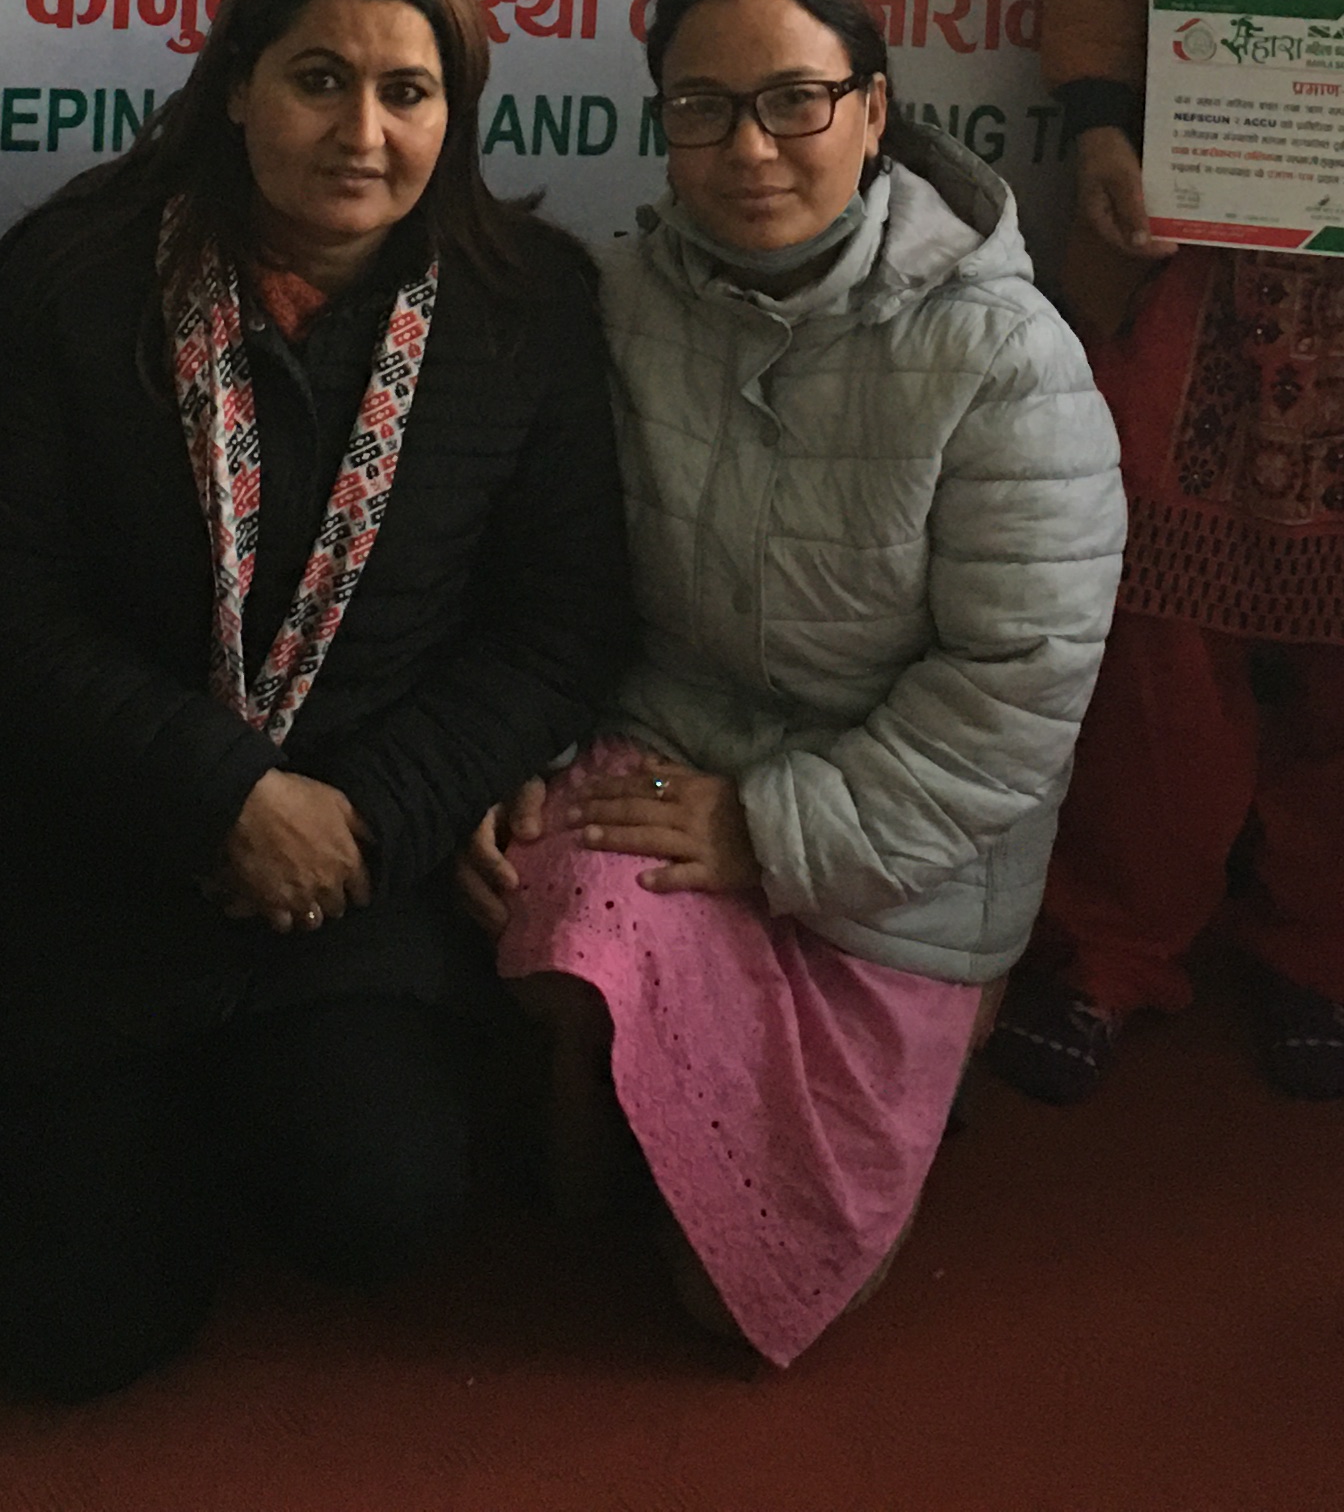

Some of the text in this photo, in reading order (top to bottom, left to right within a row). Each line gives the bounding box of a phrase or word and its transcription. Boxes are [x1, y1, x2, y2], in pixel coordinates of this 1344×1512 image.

[482, 94, 617, 156] AND
[1174, 112, 1230, 124] NEFSCUN
[1243, 117, 1277, 128] ACCU
